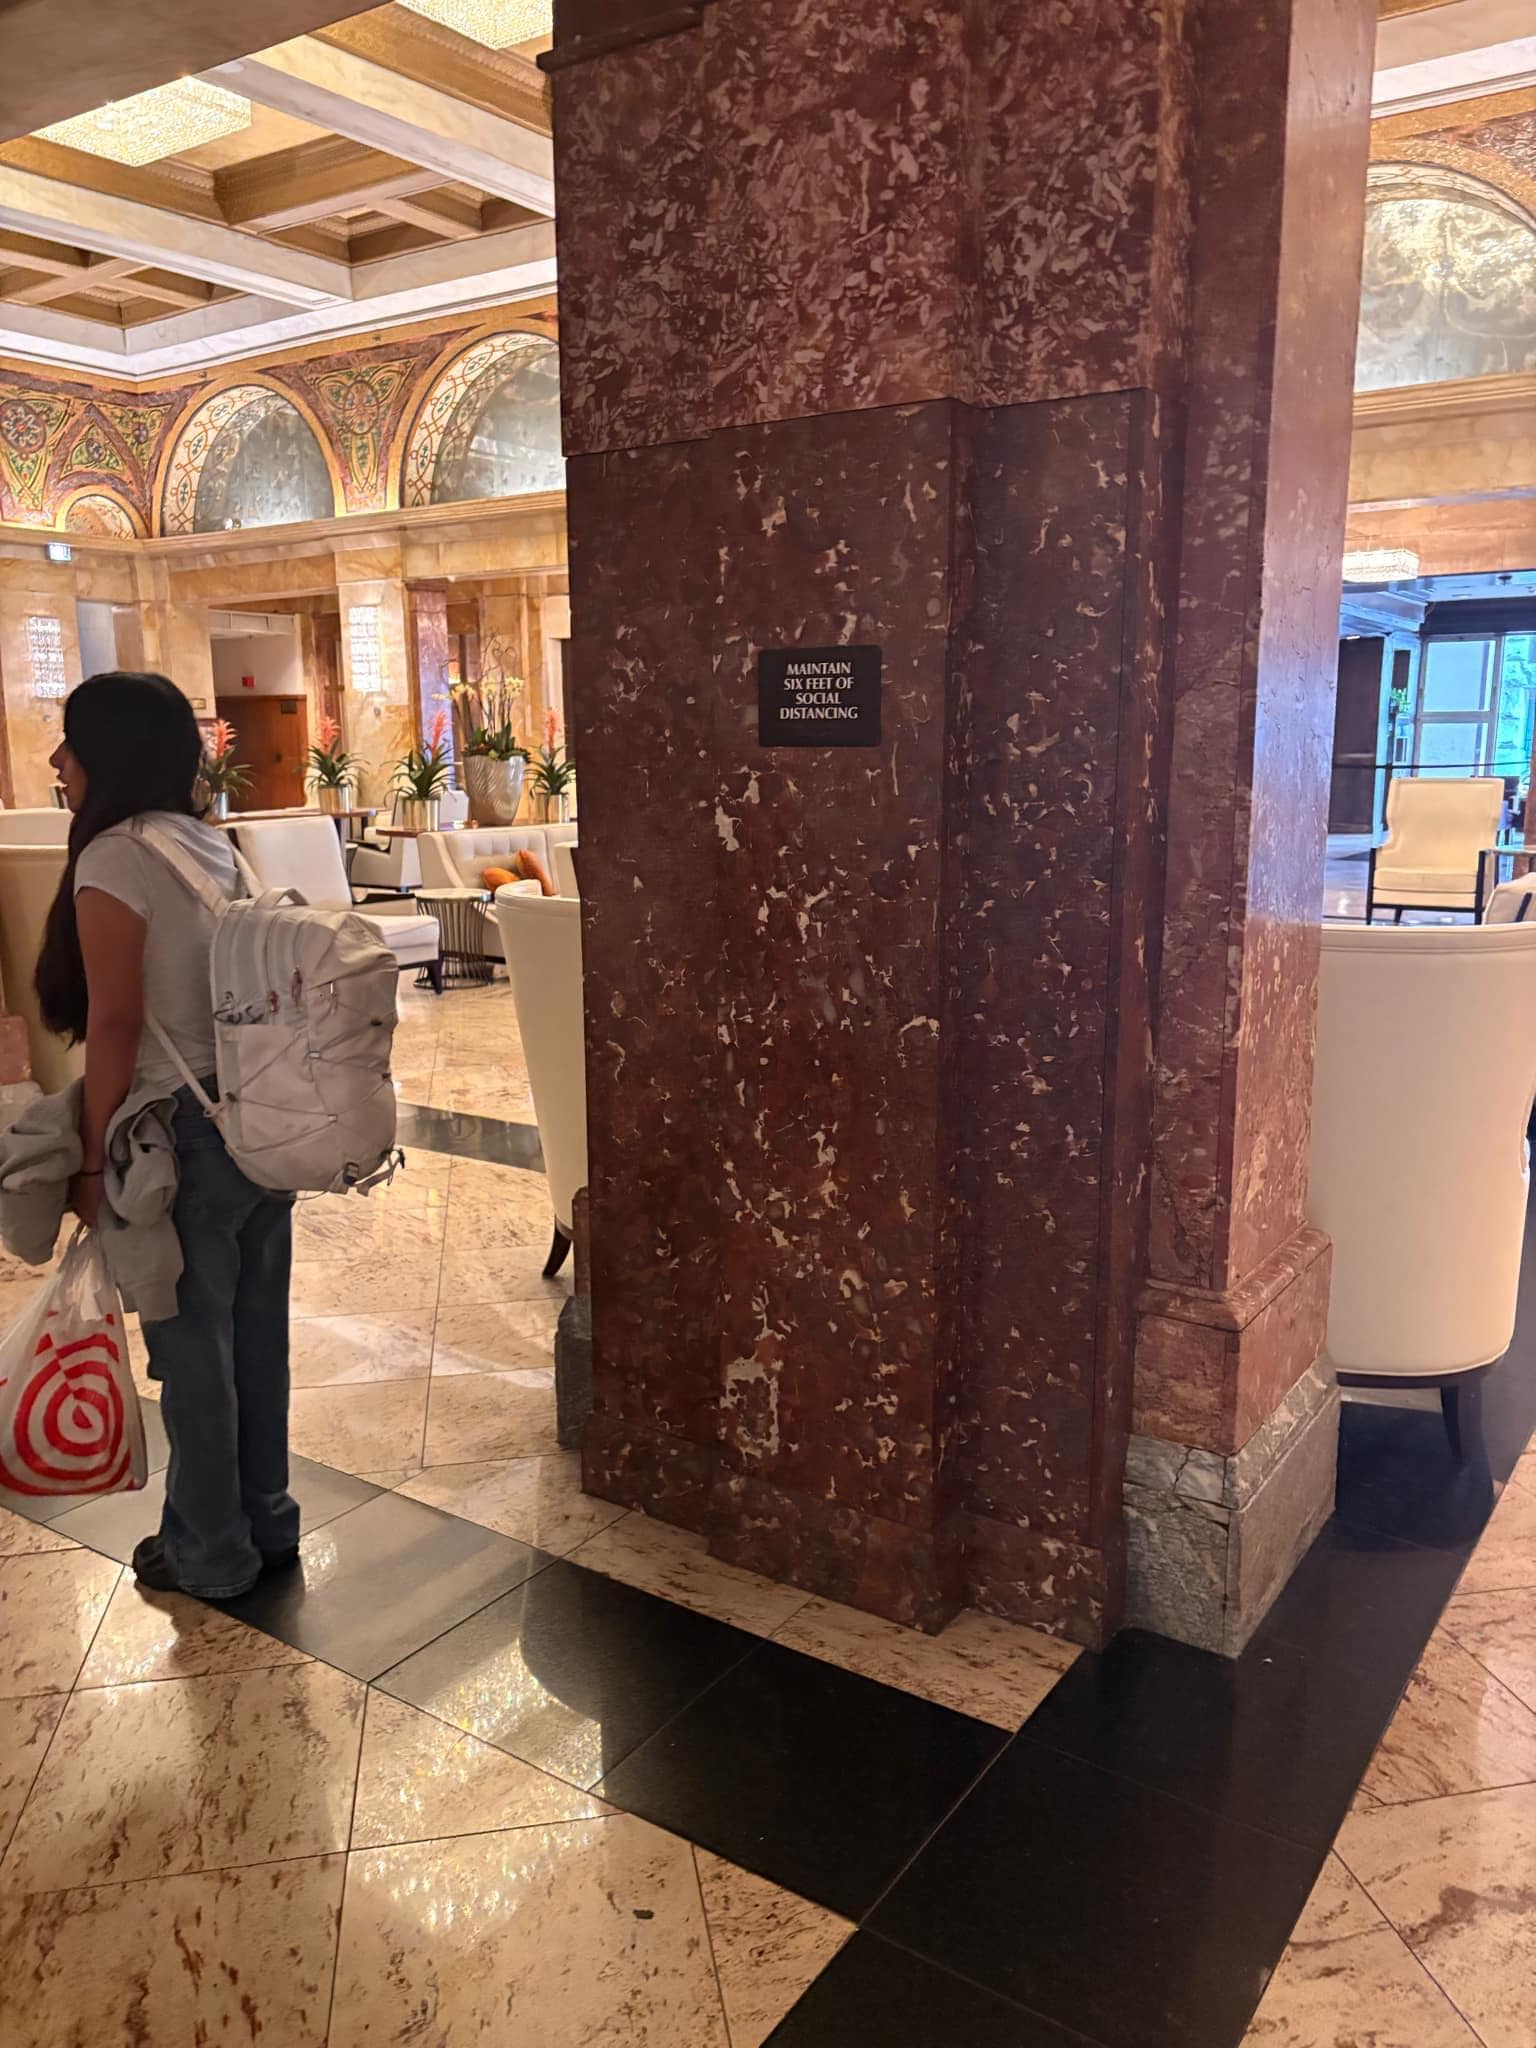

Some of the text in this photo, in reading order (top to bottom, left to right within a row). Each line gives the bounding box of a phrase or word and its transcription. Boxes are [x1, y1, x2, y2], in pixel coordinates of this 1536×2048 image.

[786, 662, 852, 675] MAINTAIN
[783, 676, 855, 690] SIX FEET OF
[795, 692, 841, 705] SOCIAL
[779, 706, 859, 720] DISTANCING
